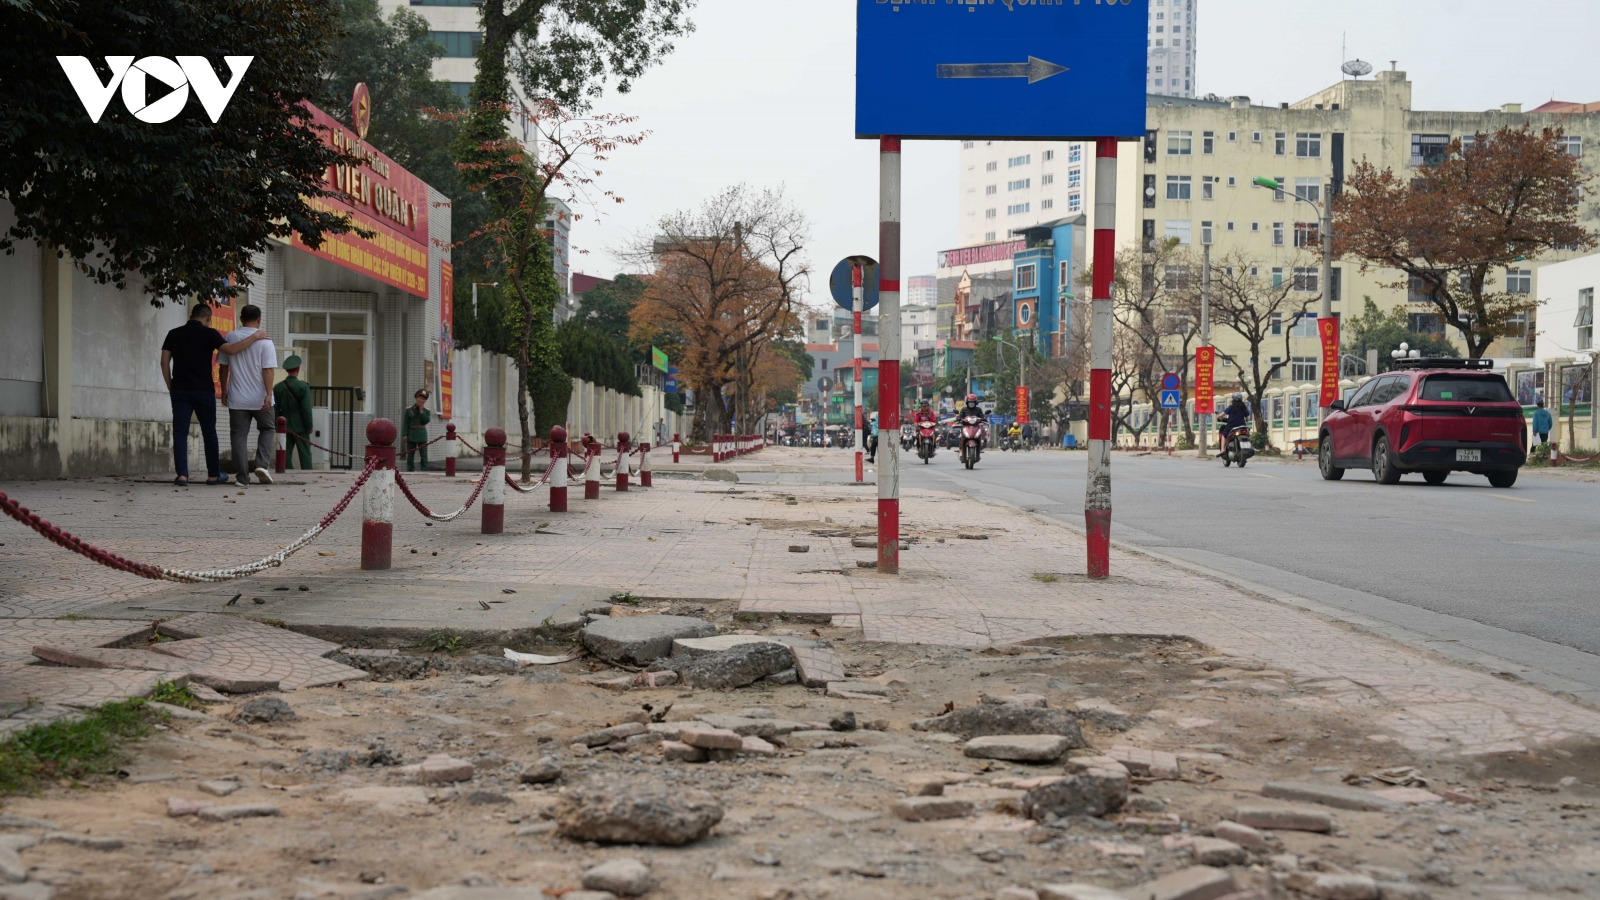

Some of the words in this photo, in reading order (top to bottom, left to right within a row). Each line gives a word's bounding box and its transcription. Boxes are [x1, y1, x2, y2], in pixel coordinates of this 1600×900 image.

[333, 128, 344, 152] BỘ
[336, 162, 370, 205] VIỆN
[375, 183, 408, 227] QUÂN
